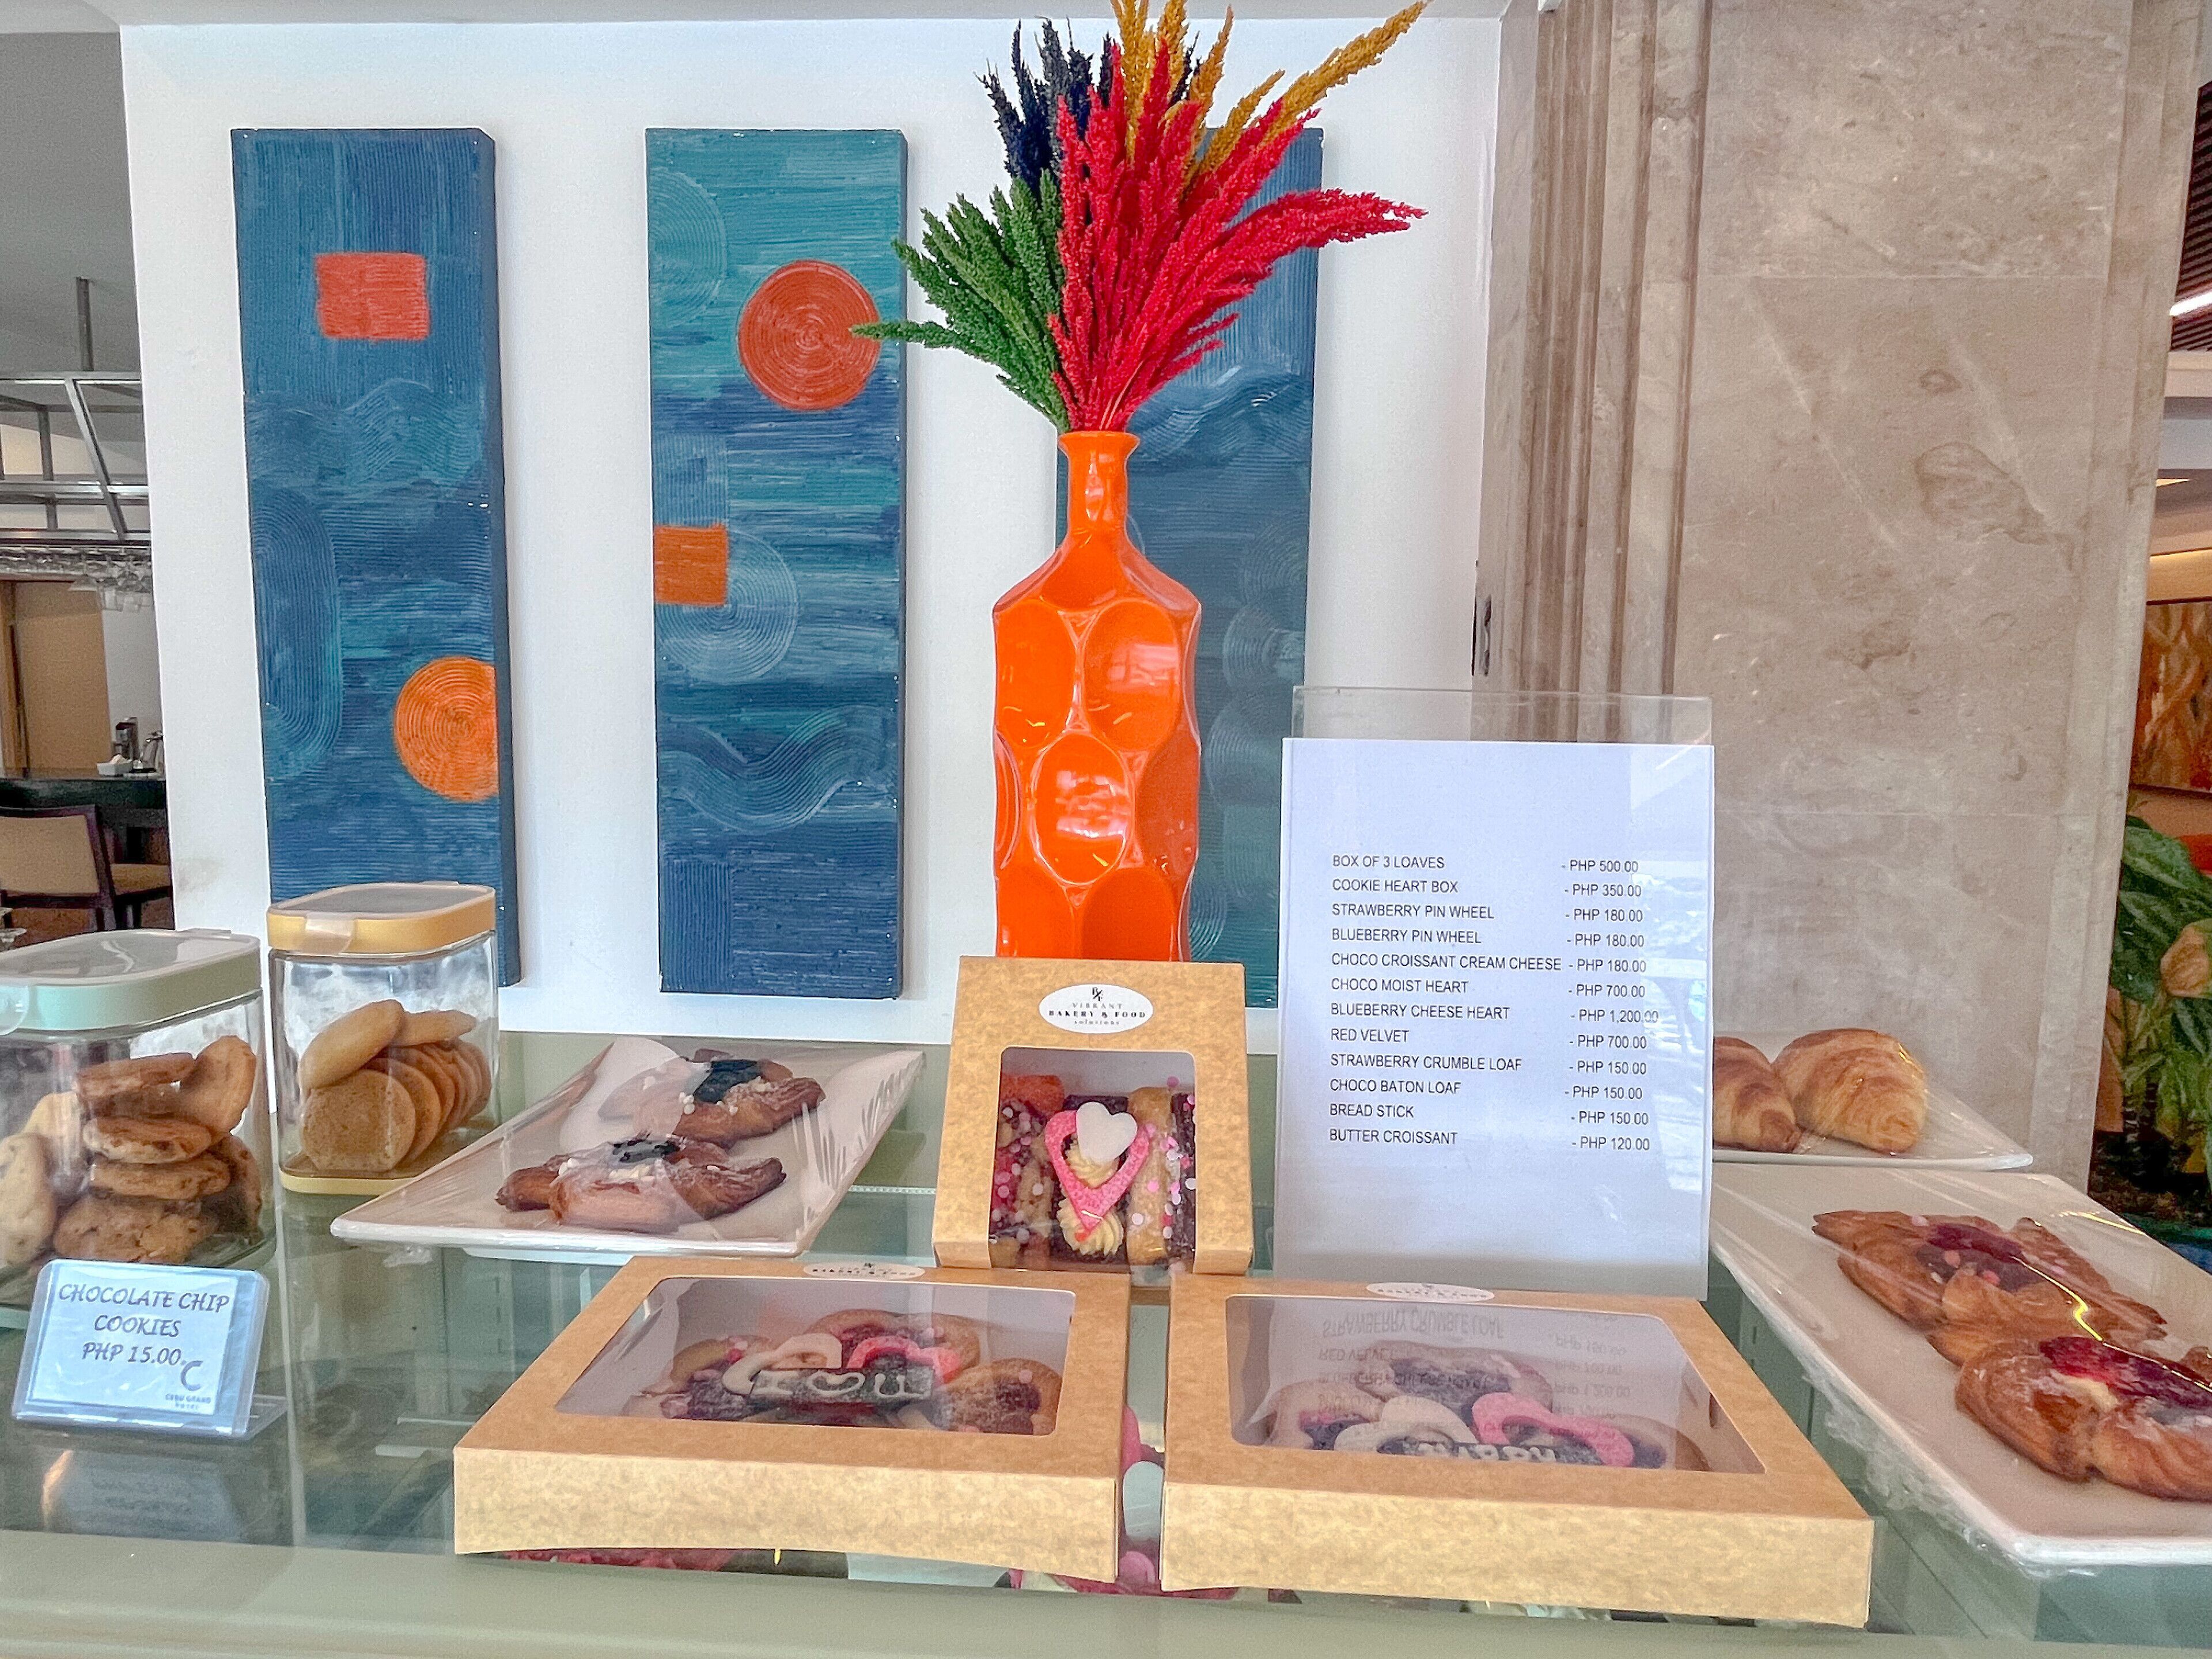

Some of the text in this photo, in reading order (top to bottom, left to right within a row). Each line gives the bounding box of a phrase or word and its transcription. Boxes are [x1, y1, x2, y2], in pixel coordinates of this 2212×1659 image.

[1332, 855, 1359, 867] BOX
[1362, 855, 1380, 868] OF
[1383, 856, 1390, 868] 3
[1393, 856, 1445, 869] LOAVES
[1570, 859, 1596, 872] PHP
[1332, 878, 1380, 892] COOKIE
[1385, 880, 1427, 892] HEART
[1431, 880, 1459, 893] BOX
[1573, 883, 1599, 896] PHP
[1332, 903, 1421, 917] STRAWBERRY
[1425, 905, 1445, 918] PIN
[1449, 906, 1495, 919] WHEEL
[1574, 908, 1600, 921] PHP
[1332, 928, 1408, 942] BLUEBERRY
[1412, 929, 1433, 942] PIN
[1436, 930, 1482, 944] WHEEL
[1575, 933, 1601, 946] PHP
[1331, 952, 1378, 967] CHOCO
[1381, 953, 1456, 968] CROISSANT
[1459, 956, 1505, 969] CREAM
[1509, 957, 1561, 971] CHEESE
[1577, 958, 1603, 971] PHP
[1331, 978, 1378, 991] CHOCO
[1381, 979, 1422, 992] MOIST
[1426, 980, 1469, 993] HEART
[1577, 983, 1603, 997] PHP
[1331, 1002, 1407, 1017] BLUEBERRY
[1411, 1005, 1463, 1018] CHEESE
[1467, 1006, 1510, 1019] HEART
[1579, 1009, 1605, 1021] PHP
[1331, 1028, 1357, 1041] RED
[1360, 1029, 1410, 1043] VELVET
[1578, 1035, 1604, 1048] PHP
[1331, 1054, 1419, 1068] STRAWBERRY
[1423, 1056, 1486, 1070] CRUMBLE
[1489, 1058, 1522, 1071] LOAF
[1577, 1060, 1604, 1073] PHP
[1330, 1078, 1377, 1092] CHOCO
[1380, 1080, 1424, 1093] BATON
[1428, 1081, 1461, 1094] LOAF
[1573, 1085, 1600, 1099] PHP
[1330, 1103, 1373, 1117] BREAD
[1377, 1105, 1414, 1118] STICK
[1579, 1111, 1605, 1124] PHP
[1330, 1128, 1379, 1142] BUTTER
[1383, 1130, 1457, 1145] CROISSANT
[1580, 1136, 1607, 1149] PHP
[58, 1283, 230, 1313] CHOCOLATE CHIP
[94, 1315, 181, 1338] COOKIES
[81, 1342, 124, 1362] PHP
